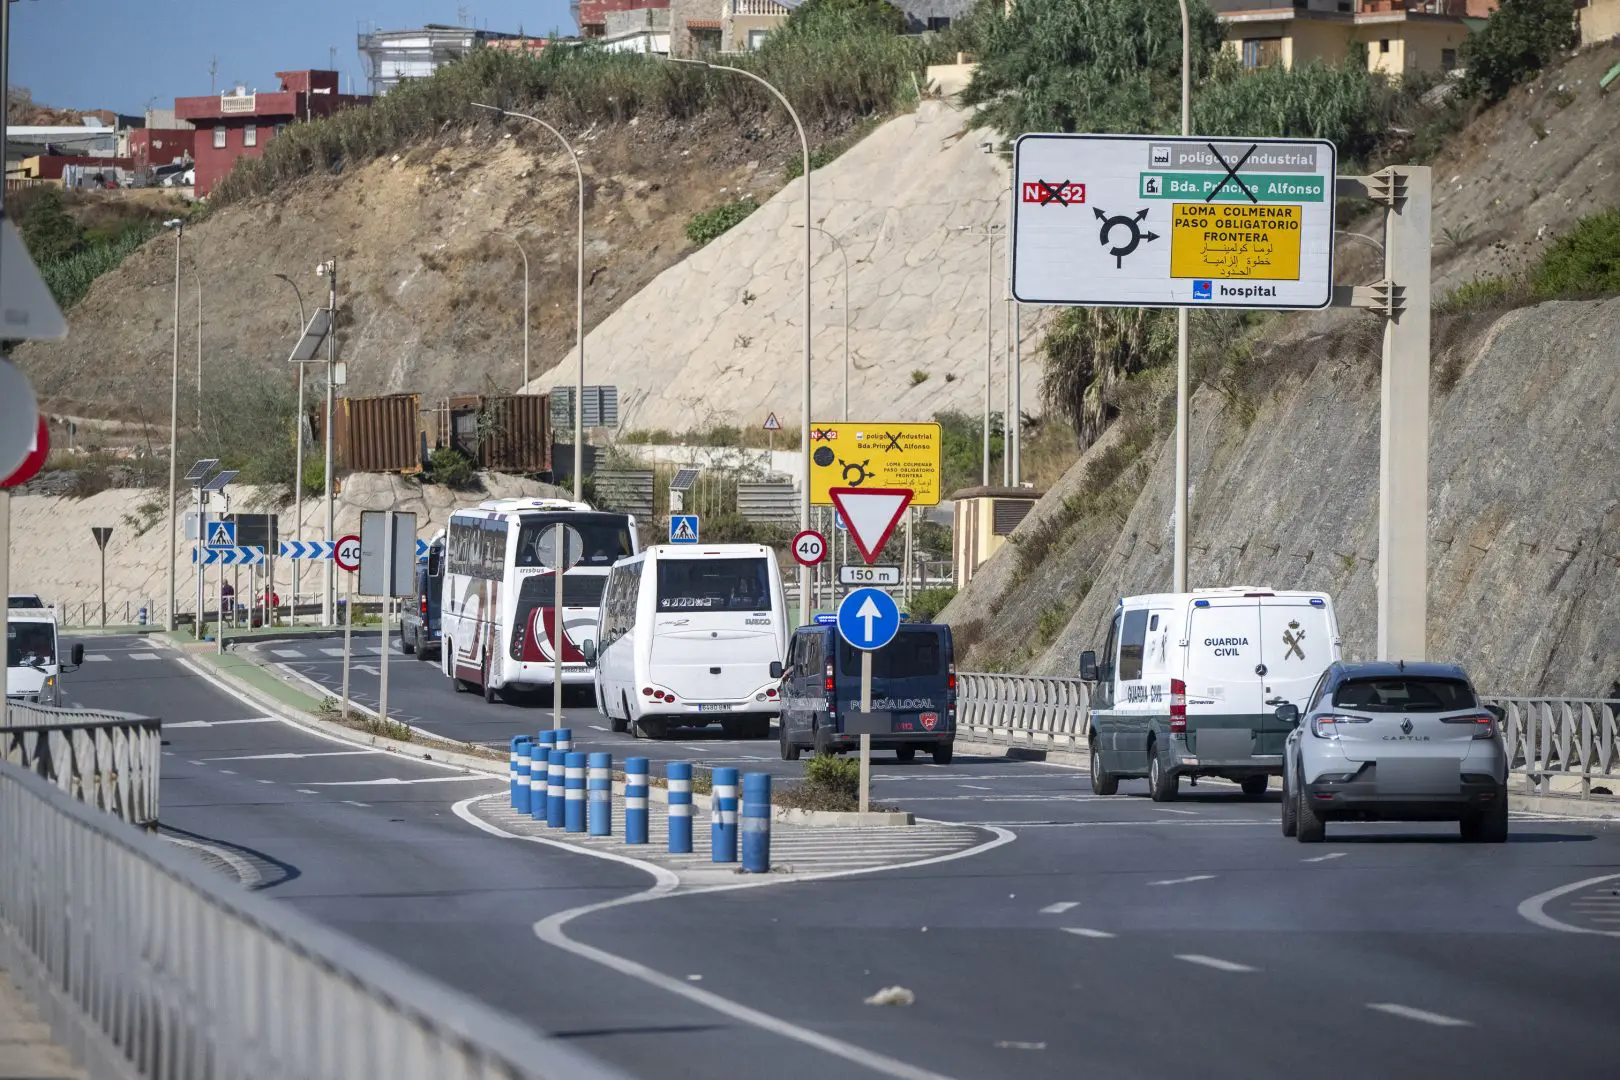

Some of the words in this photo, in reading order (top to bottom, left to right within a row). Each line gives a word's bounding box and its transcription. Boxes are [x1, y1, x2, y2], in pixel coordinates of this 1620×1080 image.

[1170, 181, 1200, 193] Bda.
[1268, 182, 1321, 195] Alfonso
[1182, 206, 1216, 216] LOMA
[1223, 207, 1292, 217] COLMENAR
[1175, 218, 1208, 228] PASO
[1215, 219, 1298, 229] OBLIGATORIO
[1204, 232, 1269, 242] FRONTERA
[1220, 285, 1277, 298] hospital
[811, 431, 837, 439] N-52
[798, 542, 820, 555] 40
[850, 569, 874, 581] 150
[878, 572, 890, 581] m
[1204, 637, 1249, 646] GUARDIA
[1214, 648, 1240, 656] CIVIL
[1127, 685, 1148, 703] GUARDIA
[850, 697, 897, 710] PICÍA
[897, 698, 935, 709] LOCAL
